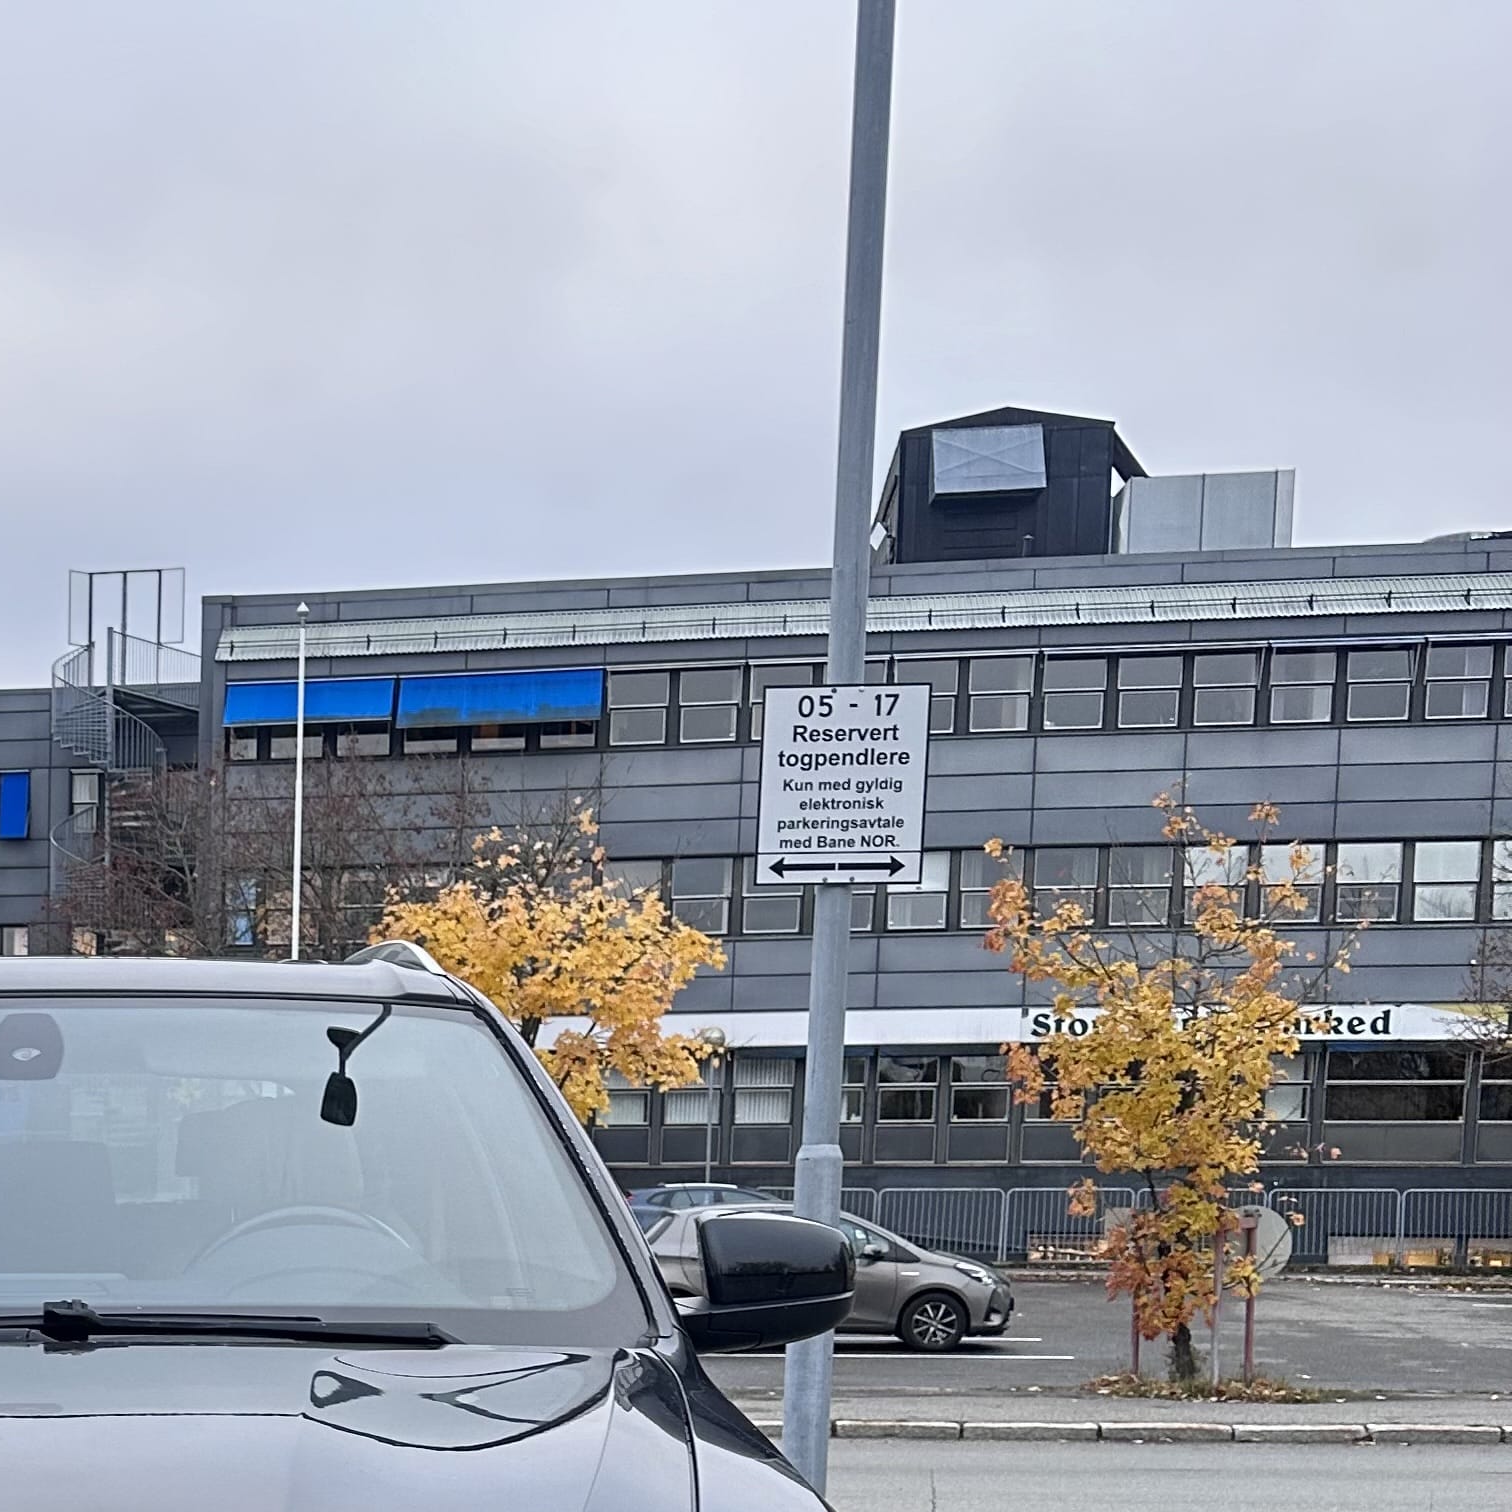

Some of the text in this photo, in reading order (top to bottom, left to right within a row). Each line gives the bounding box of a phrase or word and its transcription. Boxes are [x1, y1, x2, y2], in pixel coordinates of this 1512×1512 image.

[798, 695, 833, 717] 05
[874, 693, 900, 716] 17
[792, 724, 899, 742] Reservert
[778, 748, 910, 770] togpendlere
[783, 777, 903, 793] Kun med gyldig
[799, 797, 884, 810] elektronisk
[777, 816, 905, 832] parkeringsavtale
[779, 837, 812, 849] med
[817, 837, 856, 848] Bane
